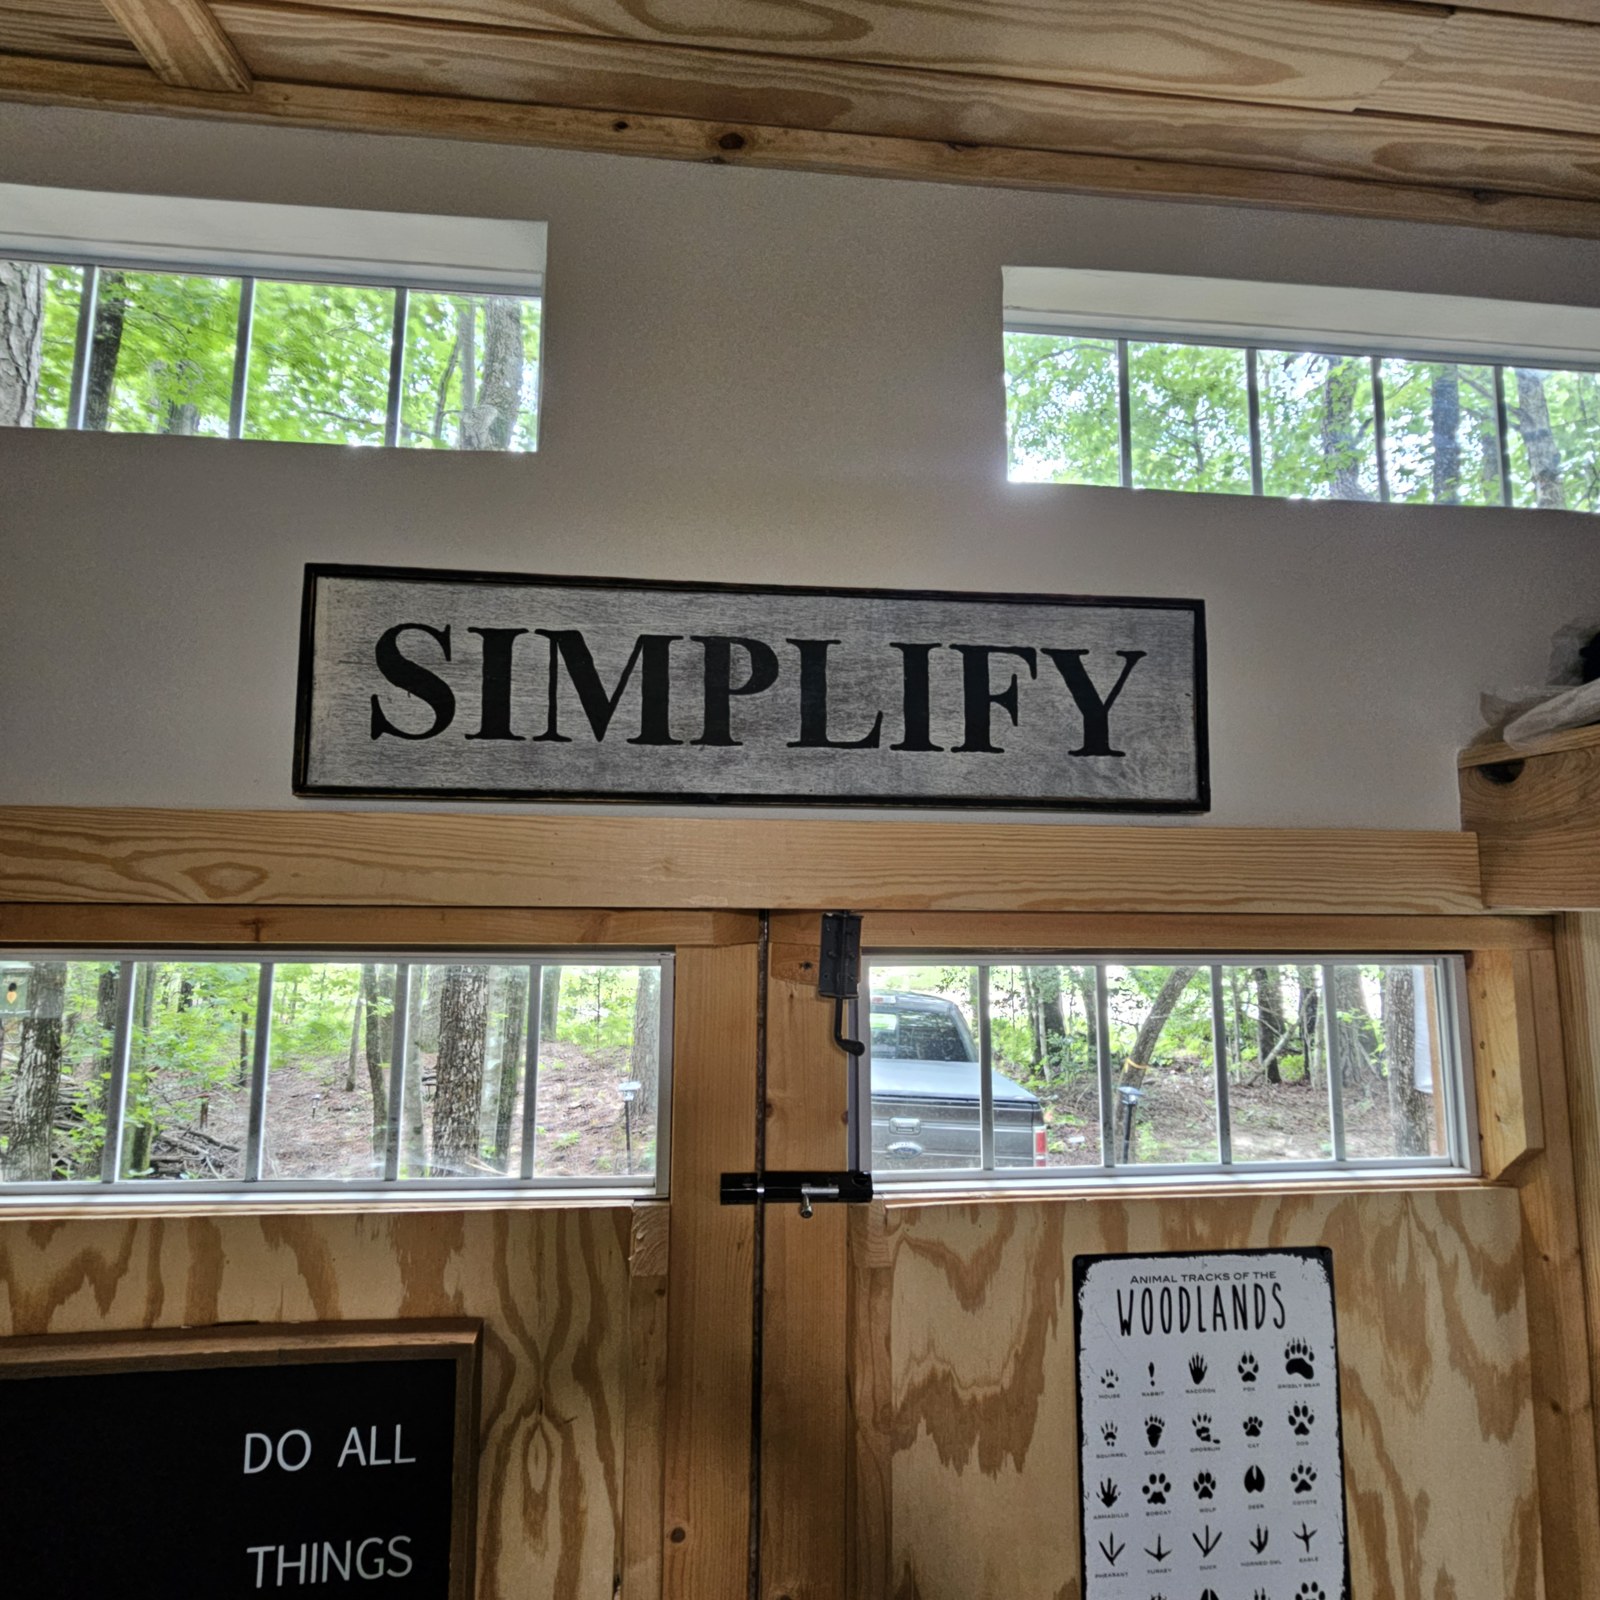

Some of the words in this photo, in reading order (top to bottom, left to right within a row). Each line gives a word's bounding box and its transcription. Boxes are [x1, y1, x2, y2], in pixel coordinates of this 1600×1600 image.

[370, 622, 1147, 757] SIMPLIFY
[1130, 1274, 1177, 1284] ANIMAL
[1181, 1272, 1230, 1283] TRACKS
[1233, 1271, 1249, 1280] OF
[1253, 1270, 1277, 1279] THE
[1117, 1282, 1286, 1336] WOODLANDS
[243, 1430, 312, 1474] DO
[337, 1424, 416, 1468] ALL
[246, 1536, 412, 1588] THINGS
